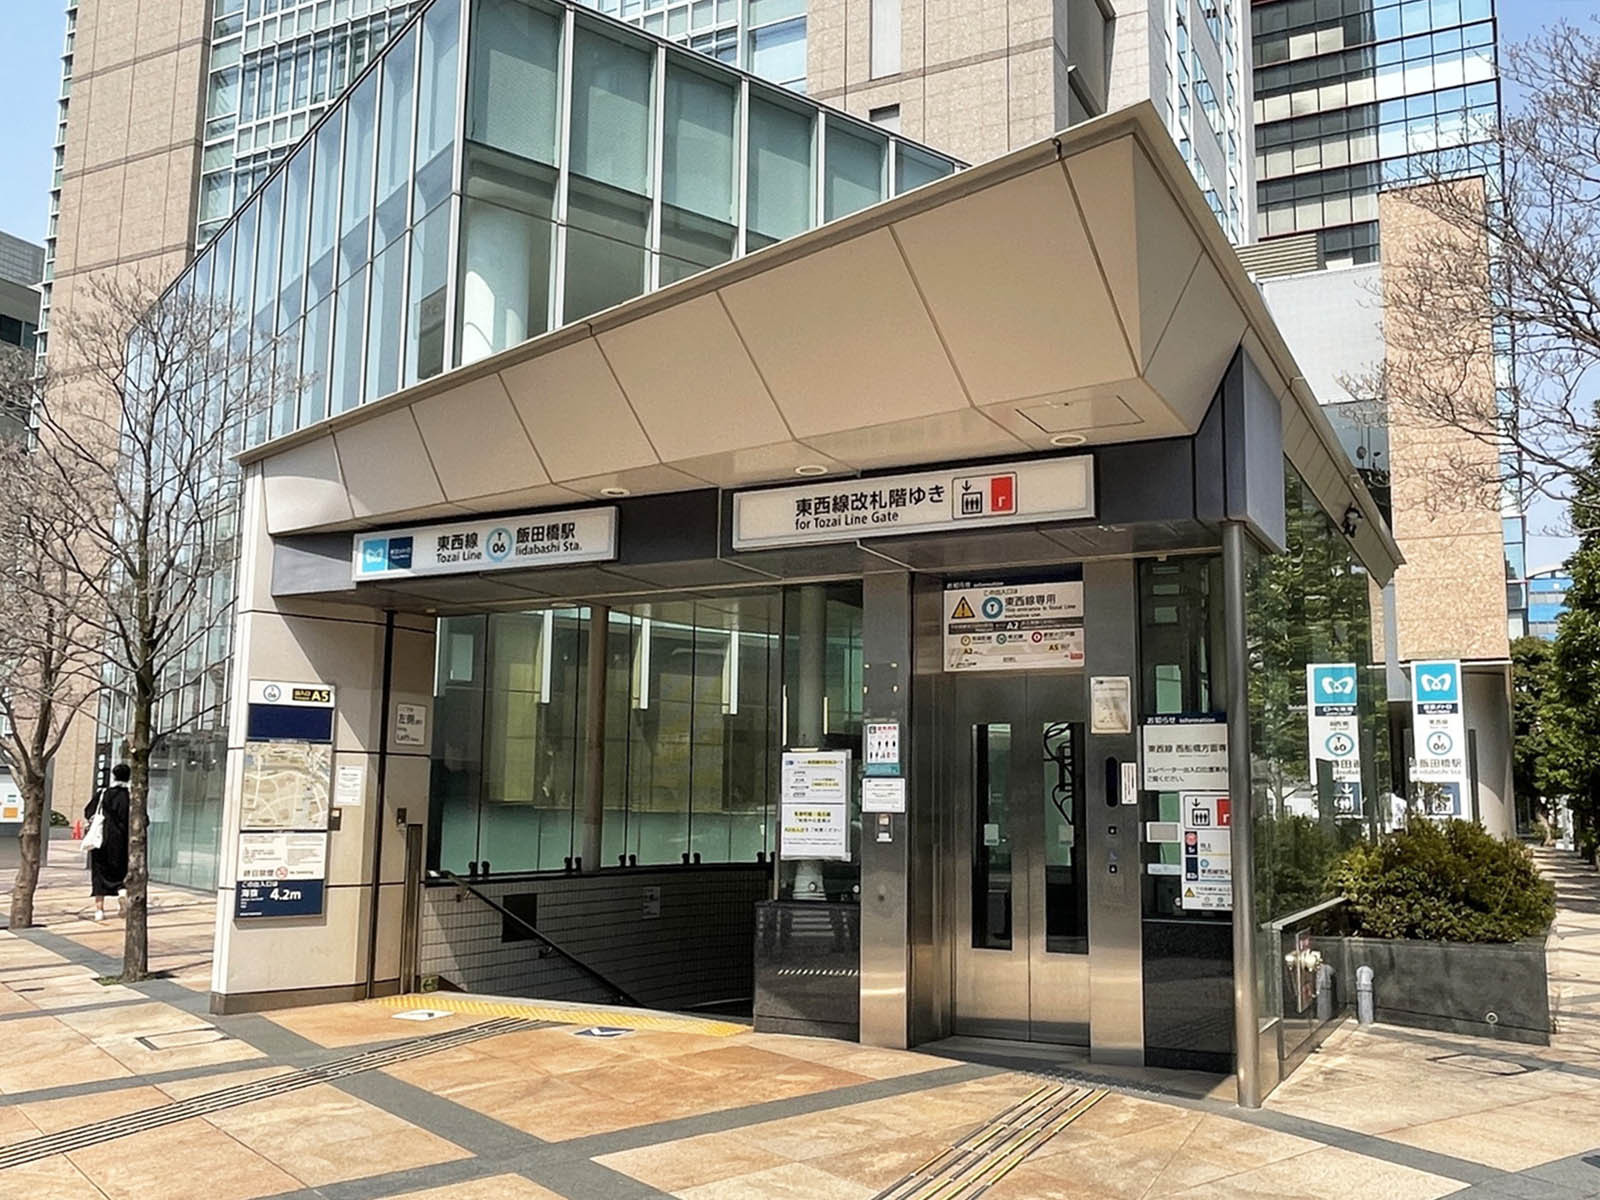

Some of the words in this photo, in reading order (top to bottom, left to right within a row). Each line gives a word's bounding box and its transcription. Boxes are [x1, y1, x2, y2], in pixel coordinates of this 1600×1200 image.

[795, 484, 945, 517] 東西線改札階ゆき
[795, 518, 811, 530] for
[813, 514, 841, 529] Tozai
[844, 513, 868, 526] Line
[871, 511, 899, 523] Gate
[436, 532, 478, 552] 東西線
[516, 522, 576, 544] 飯田橋駅
[497, 532, 502, 541] T
[492, 542, 506, 554] 06
[515, 542, 560, 556] Iidabashi
[563, 541, 582, 552] Sta.
[436, 551, 460, 563] Tozai
[462, 550, 482, 562] Line
[990, 603, 995, 611] T
[312, 690, 329, 702] A5
[1433, 742, 1447, 751] 06
[269, 887, 302, 901] 4.2m
